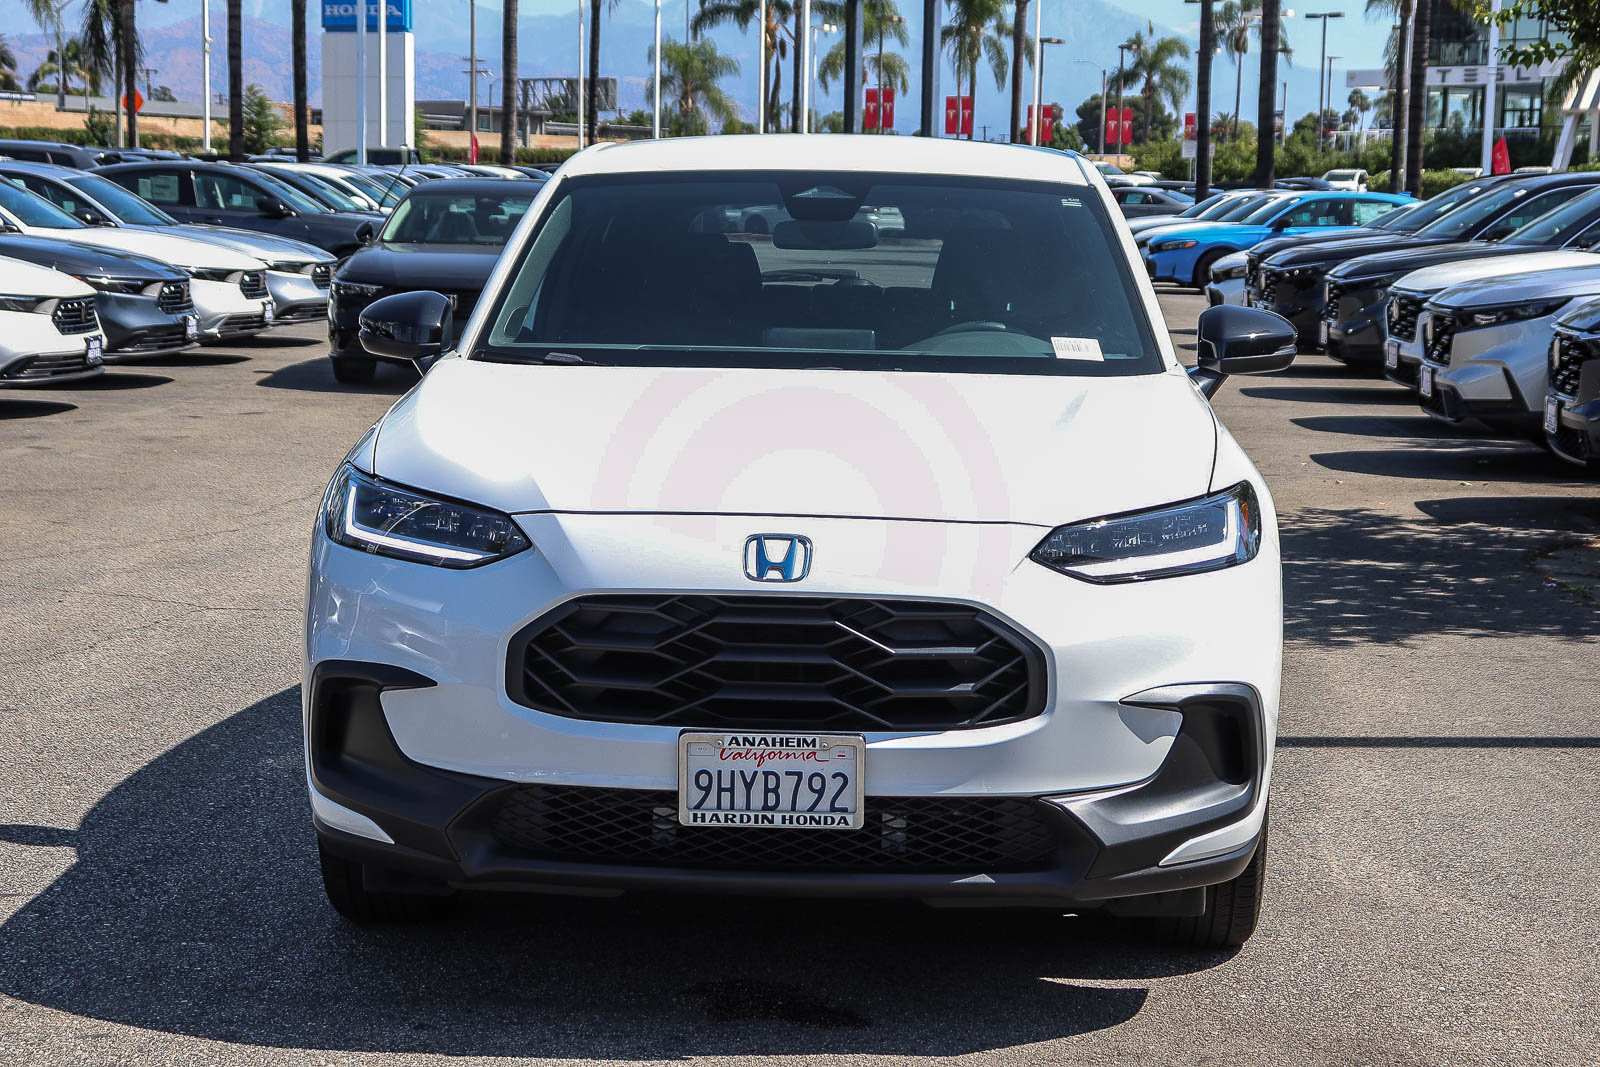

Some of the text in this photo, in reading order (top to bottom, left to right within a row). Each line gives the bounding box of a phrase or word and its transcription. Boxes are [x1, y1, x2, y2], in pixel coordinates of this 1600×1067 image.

[1436, 67, 1531, 83] TESL
[727, 736, 817, 748] ANAHEIM
[719, 748, 830, 767] California
[693, 769, 849, 813] 9HYB792
[692, 812, 850, 826] HARDIN HONDA
